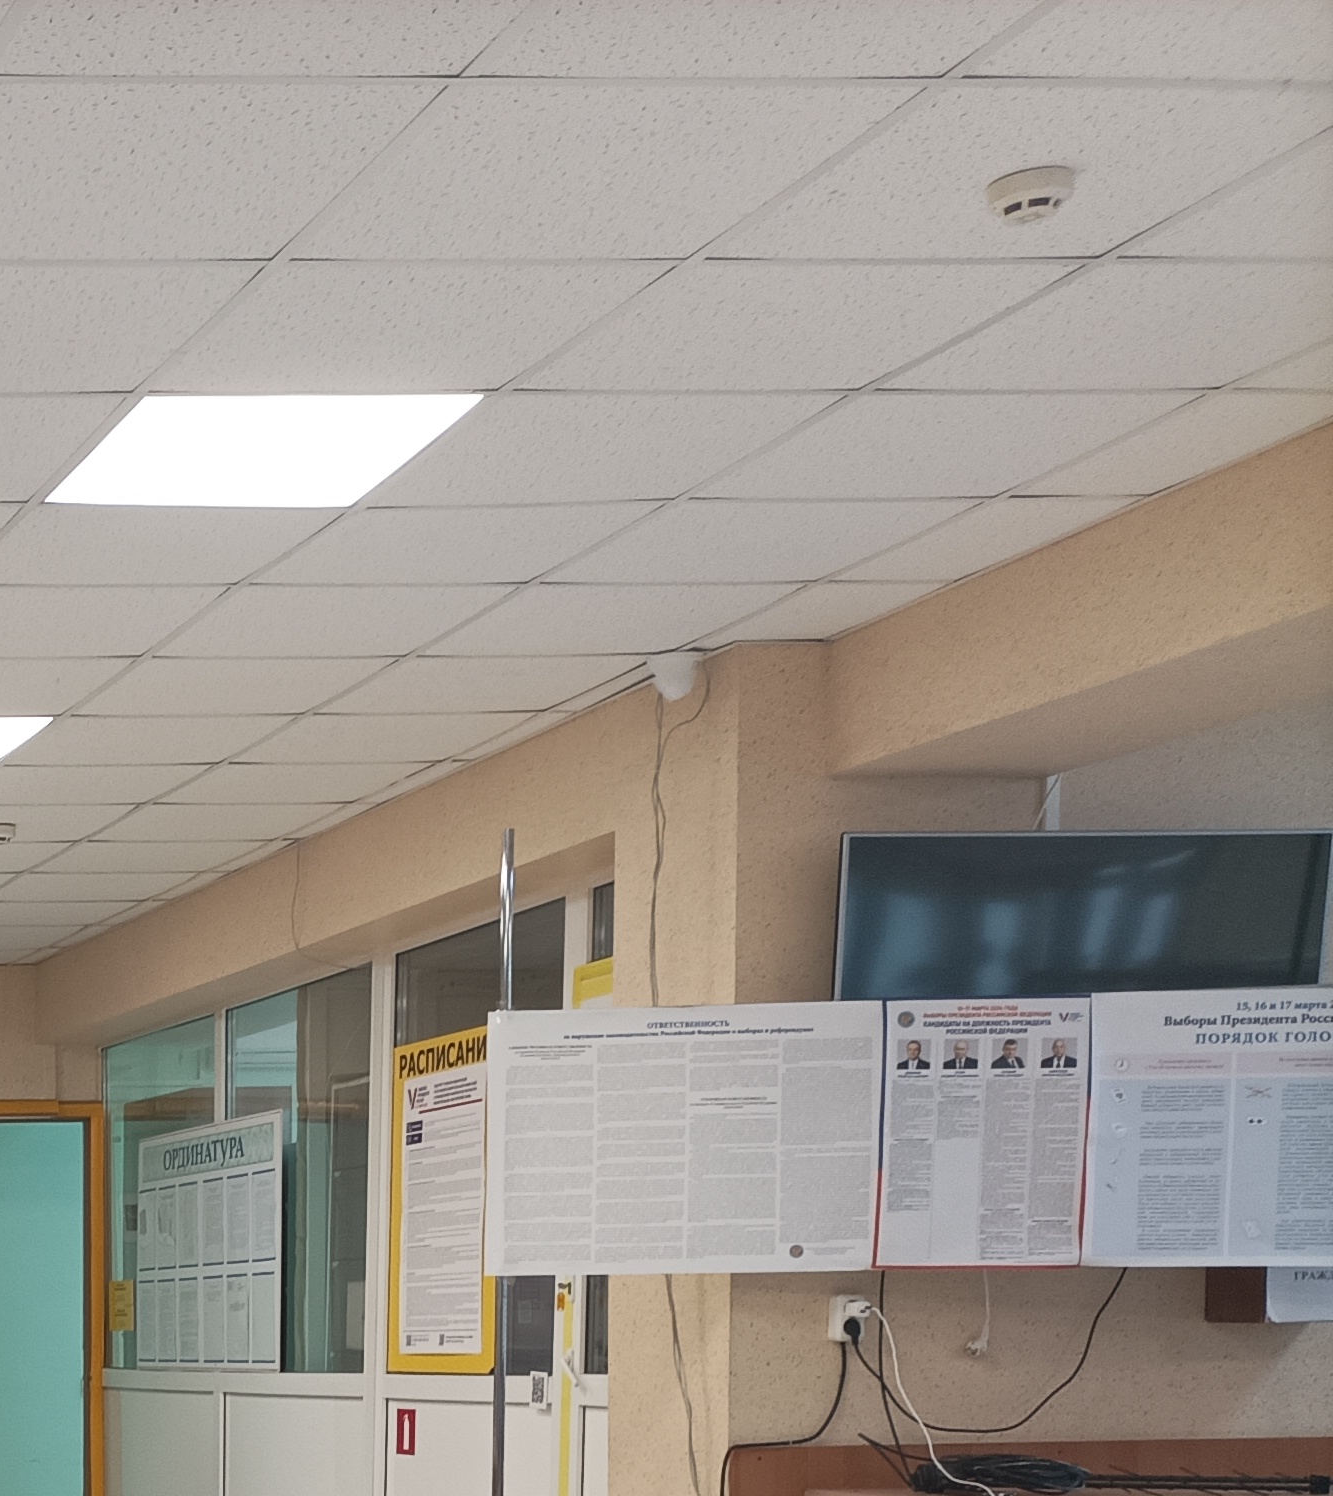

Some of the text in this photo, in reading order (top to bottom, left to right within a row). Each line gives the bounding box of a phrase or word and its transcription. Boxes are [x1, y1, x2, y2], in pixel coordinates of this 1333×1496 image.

[1294, 1002, 1327, 1012] марта
[1164, 1015, 1217, 1028] Выборы
[1220, 1014, 1297, 1028] Президента
[1195, 1030, 1332, 1045] ПОРЯДОК ГОЛО
[398, 1033, 487, 1079] РАСПИСАНИ
[162, 1136, 245, 1171] ОРДИНАТУРА
